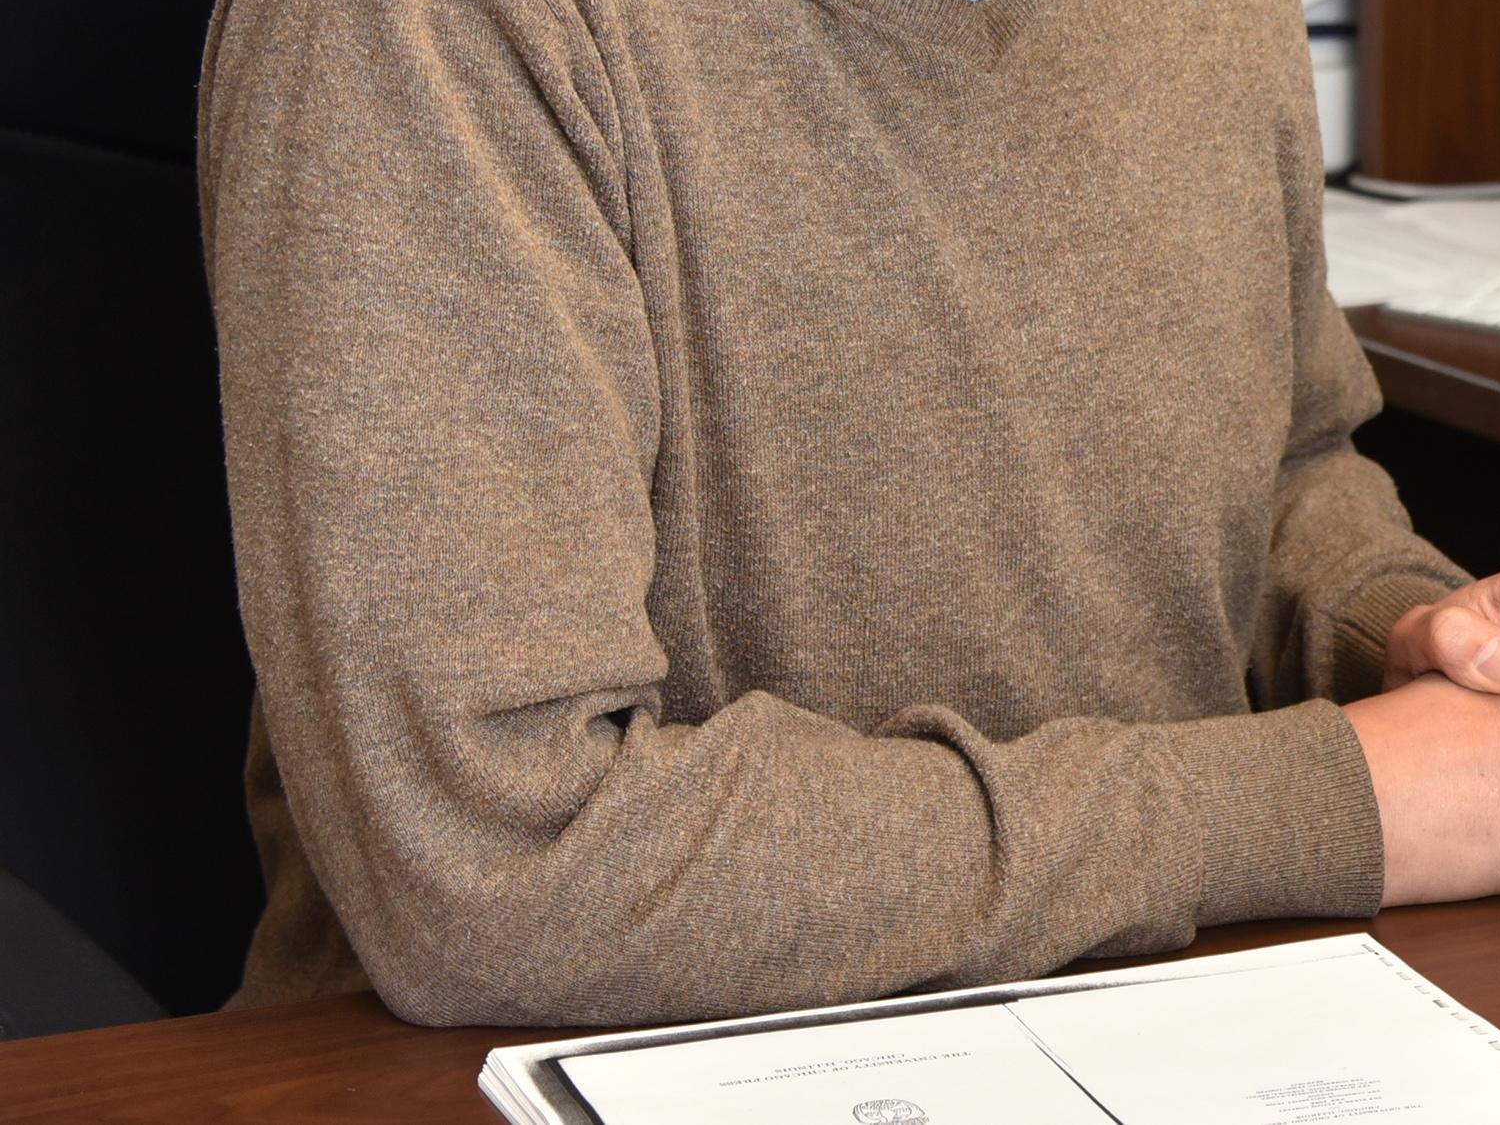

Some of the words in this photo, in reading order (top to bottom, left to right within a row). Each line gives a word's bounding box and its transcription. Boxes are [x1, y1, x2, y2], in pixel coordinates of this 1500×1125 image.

[774, 1061, 835, 1073] ILLINOIS
[855, 1056, 937, 1069] UNIVERSITY
[764, 1069, 826, 1080] CHICAGO
[719, 1077, 760, 1086] PRESS
